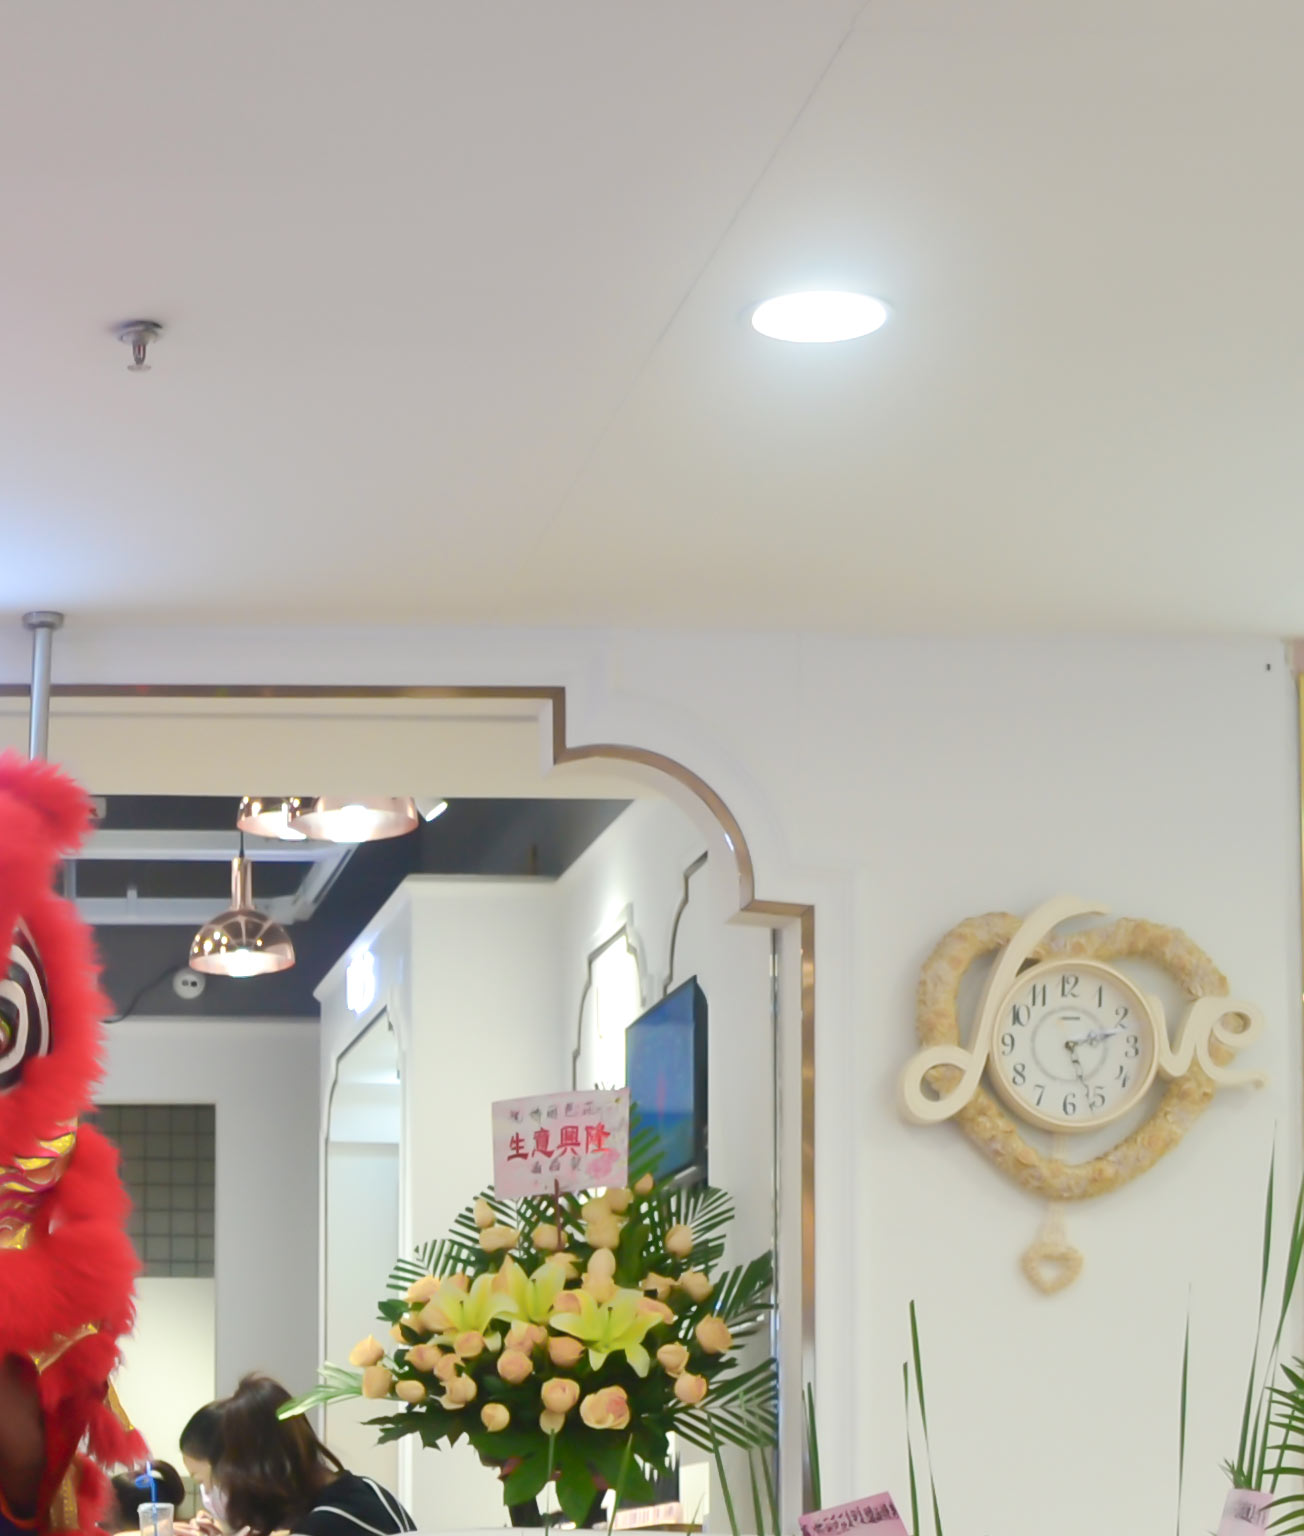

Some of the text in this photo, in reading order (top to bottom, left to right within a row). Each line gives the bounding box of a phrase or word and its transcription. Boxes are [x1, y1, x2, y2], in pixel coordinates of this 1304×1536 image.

[1031, 984, 1047, 1007] 11
[1060, 974, 1080, 998] 12
[1097, 985, 1103, 1008] 1
[1011, 1004, 1031, 1027] 10
[1114, 1006, 1130, 1029] 2
[1001, 1032, 1015, 1056] 9
[1124, 1035, 1139, 1058] 3
[1012, 1063, 1026, 1086] 8
[1114, 1064, 1130, 1088] 4
[1033, 1084, 1045, 1107] 7
[1062, 1092, 1077, 1116] 6
[1090, 1086, 1106, 1108] 5
[506, 1121, 611, 1162] 生意興隆
